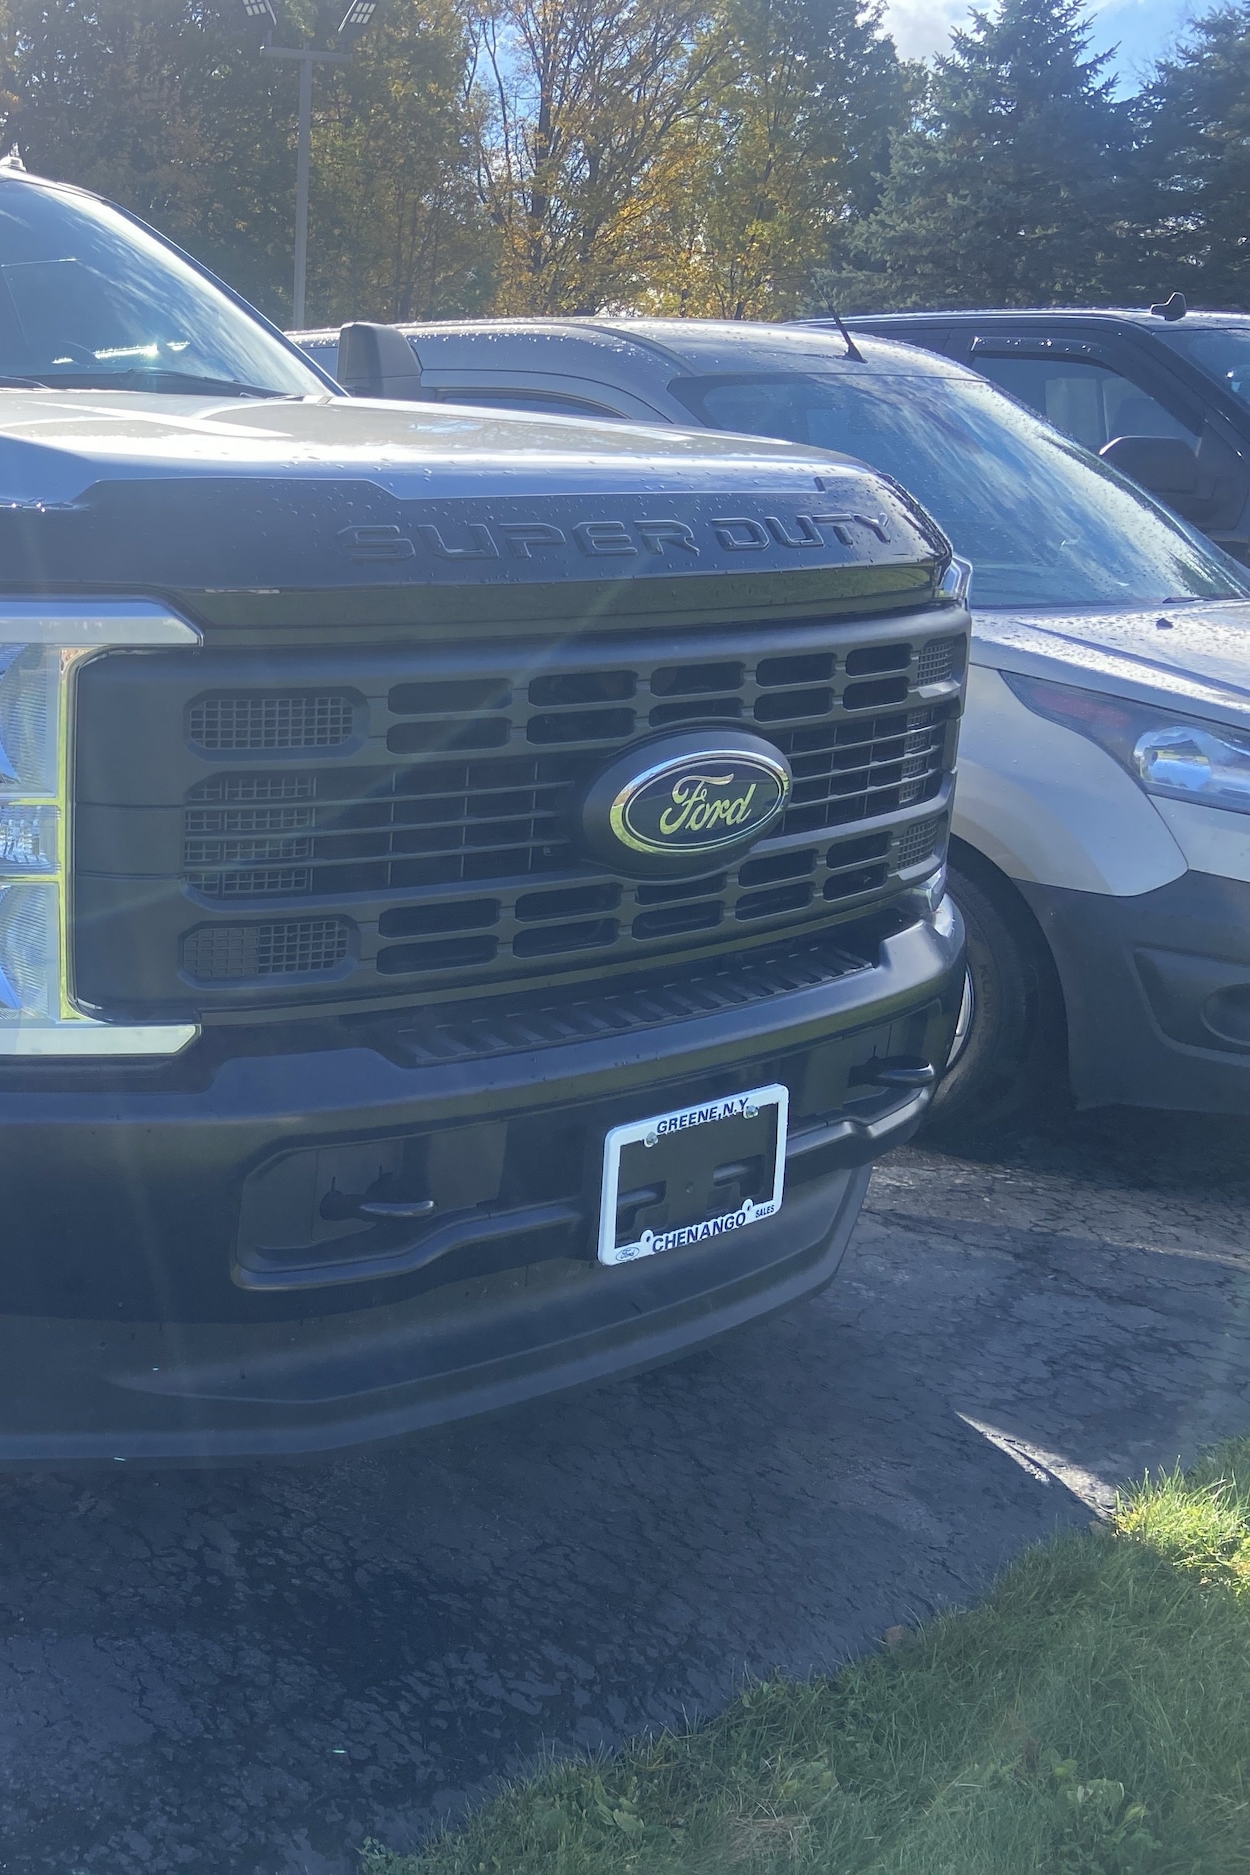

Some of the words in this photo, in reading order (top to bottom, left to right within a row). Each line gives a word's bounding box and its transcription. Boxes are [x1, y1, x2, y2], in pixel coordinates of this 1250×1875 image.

[336, 520, 701, 561] SUPER
[709, 512, 892, 552] DUTY
[659, 773, 756, 835] Ford
[652, 1211, 747, 1253] CHENANGO
[755, 1204, 775, 1219] SALES
